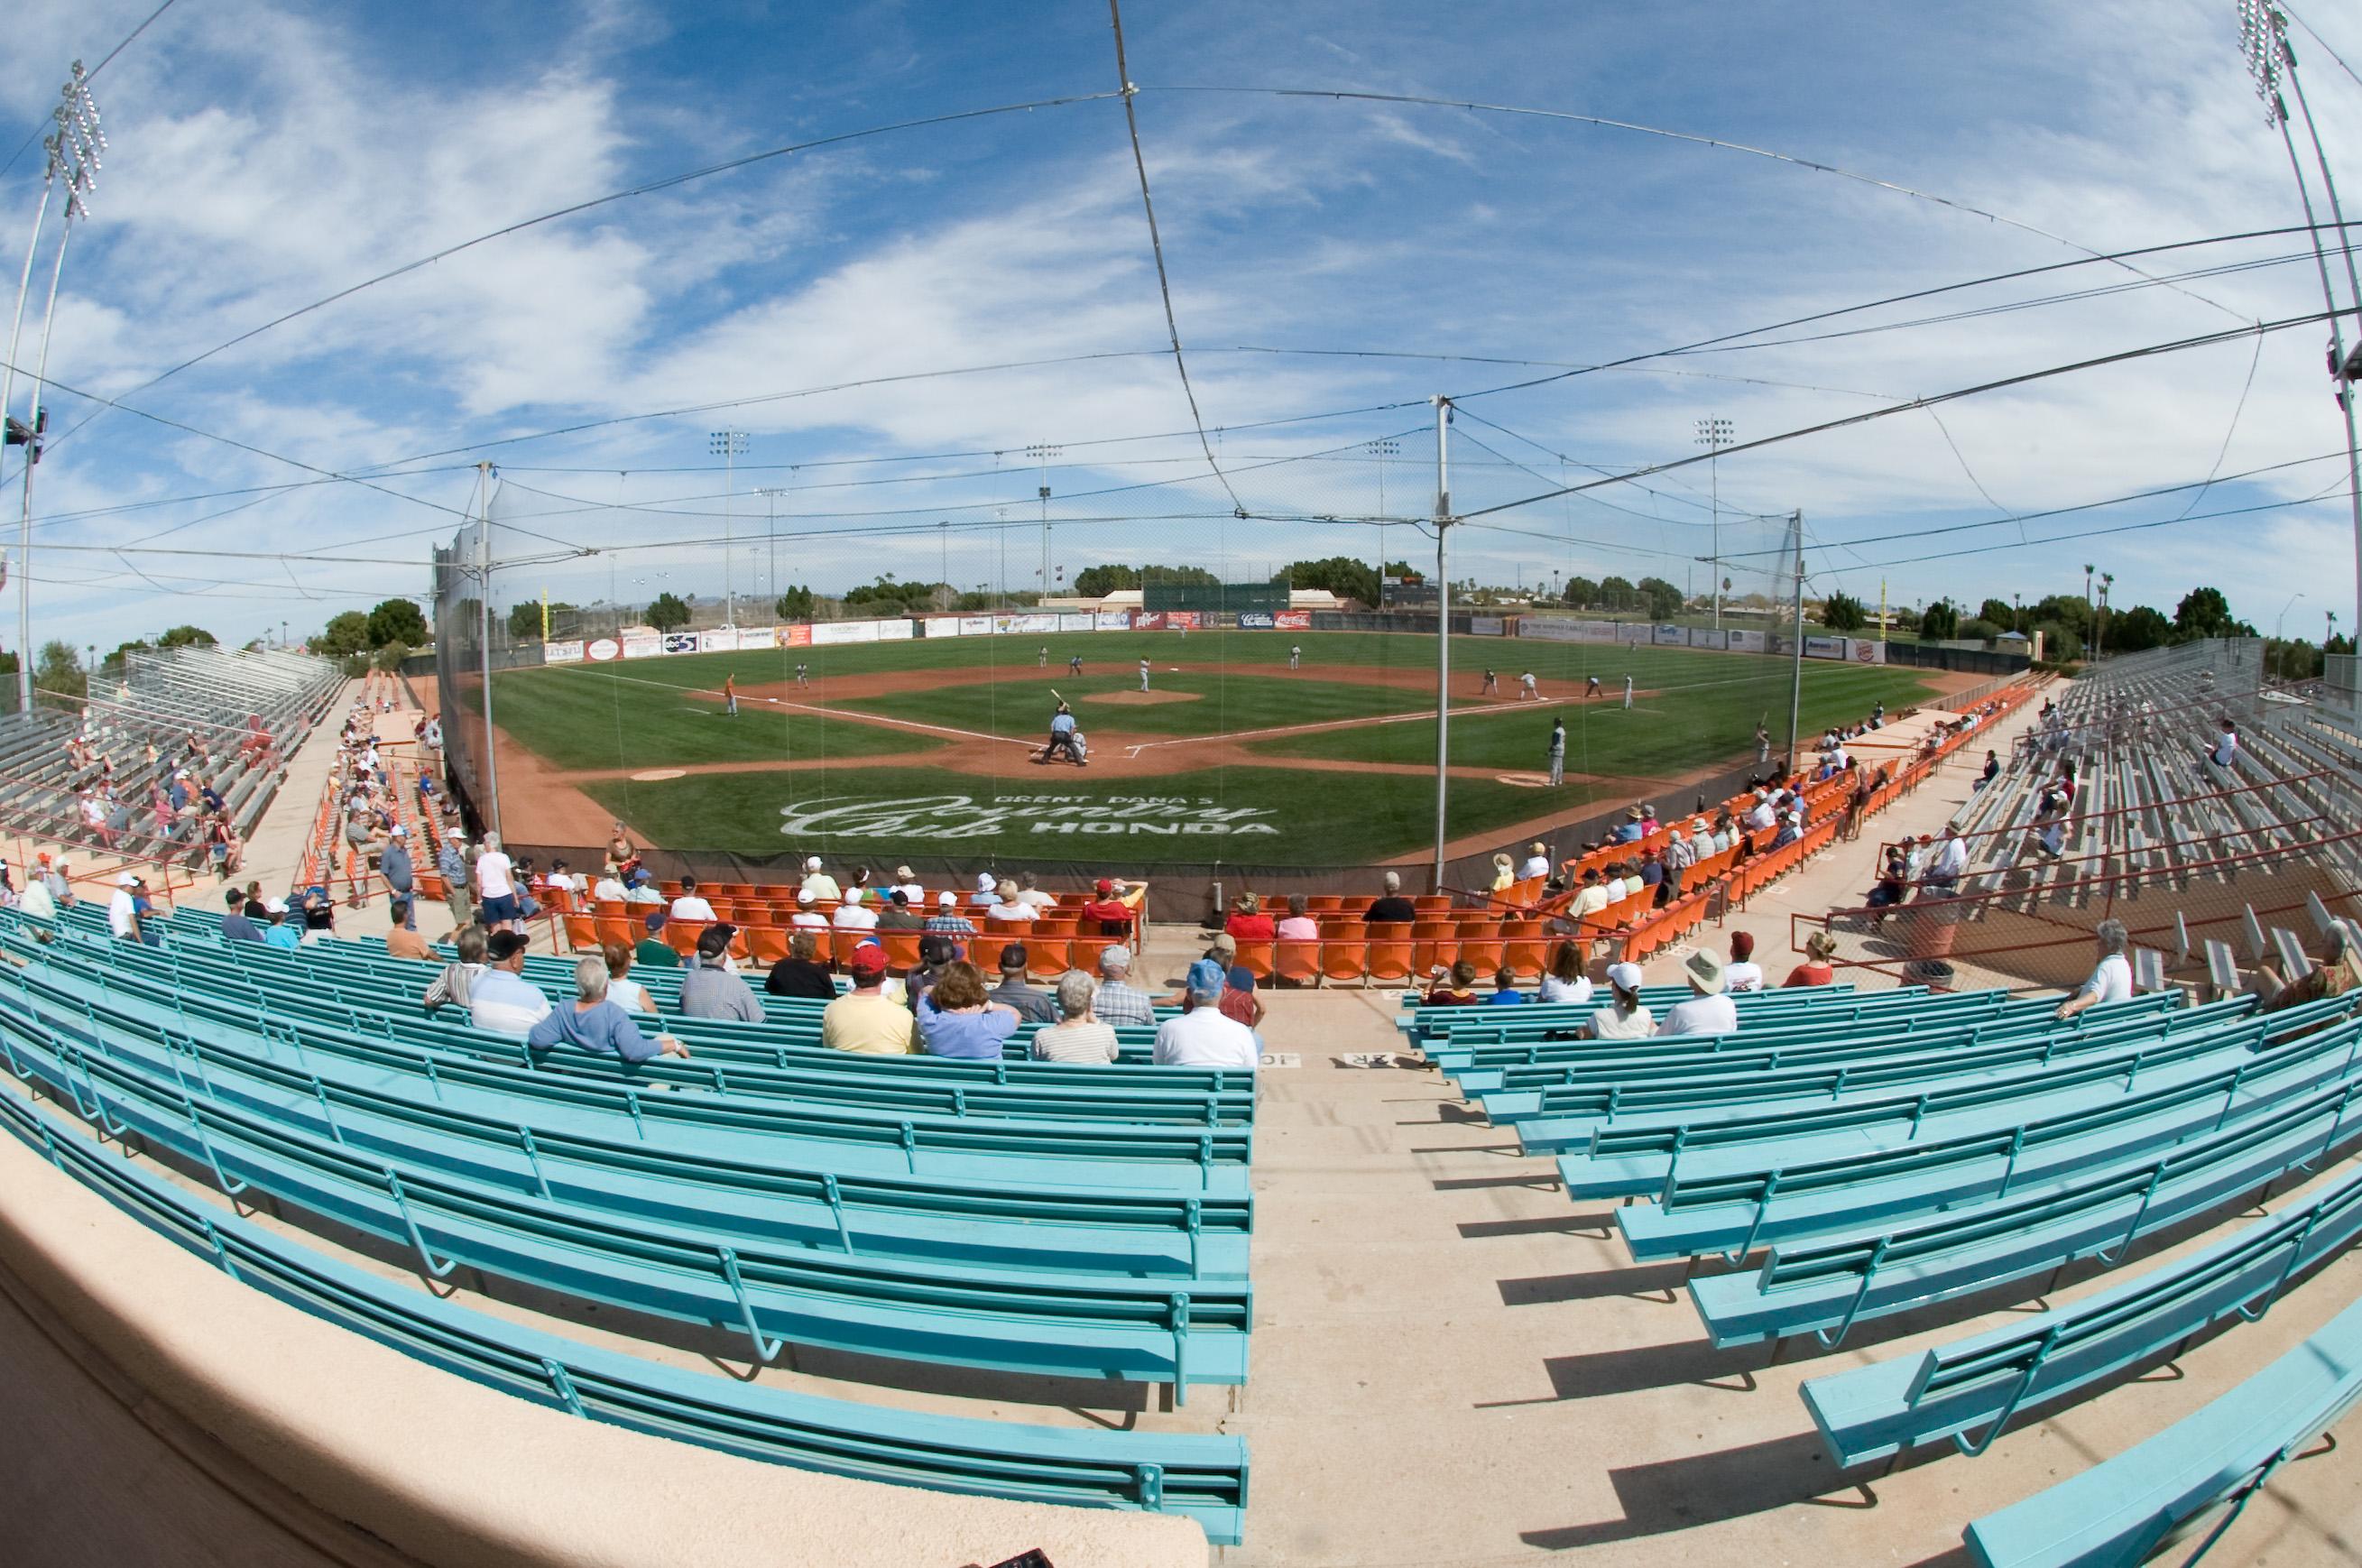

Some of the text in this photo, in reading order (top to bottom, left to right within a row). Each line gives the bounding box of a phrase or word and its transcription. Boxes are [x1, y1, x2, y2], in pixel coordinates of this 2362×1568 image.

[1121, 614, 1128, 624] 9
[1108, 796, 1213, 804] DANA'S
[1030, 822, 1279, 835] HONDA
